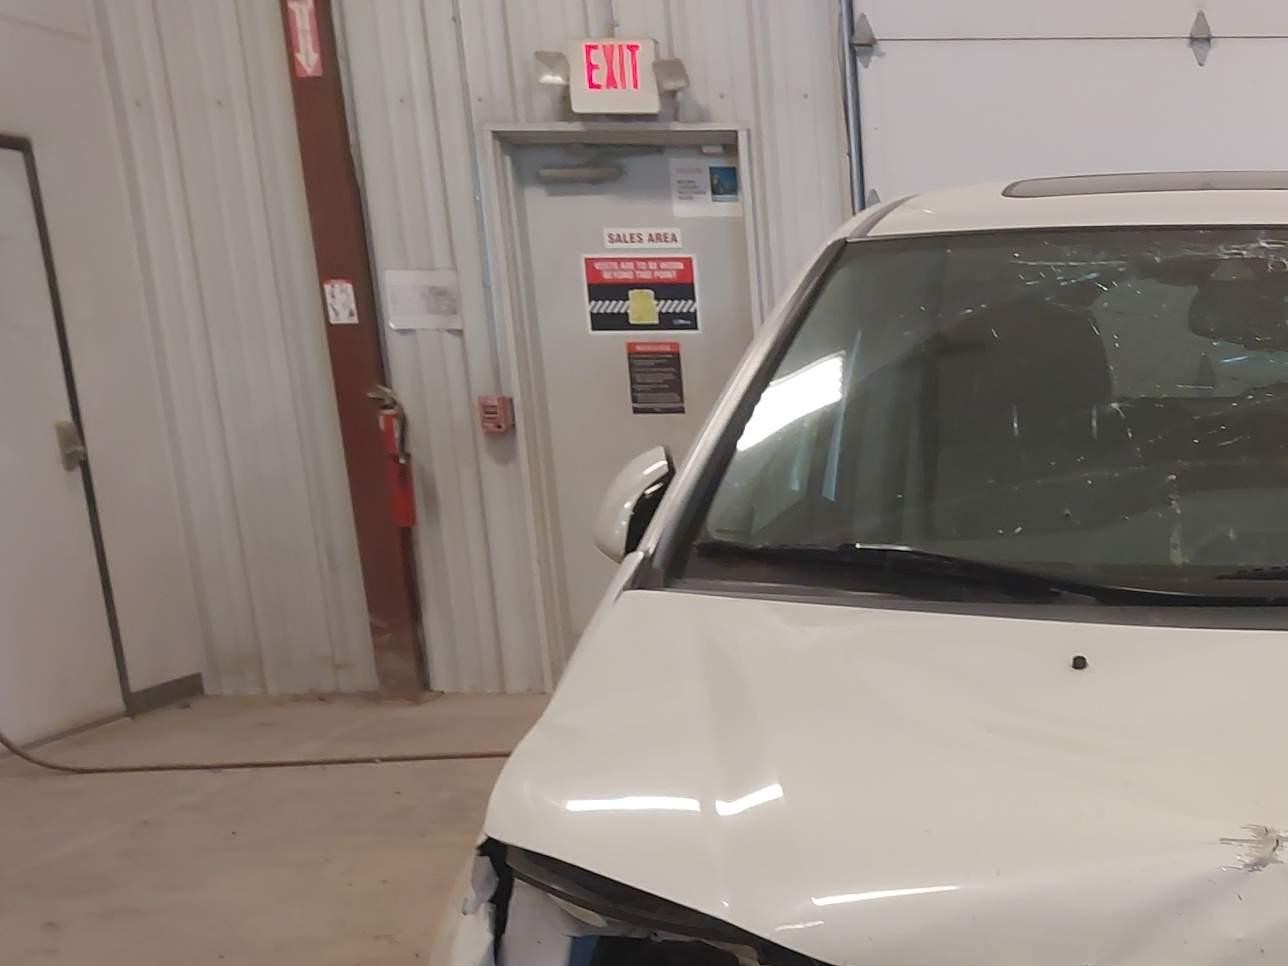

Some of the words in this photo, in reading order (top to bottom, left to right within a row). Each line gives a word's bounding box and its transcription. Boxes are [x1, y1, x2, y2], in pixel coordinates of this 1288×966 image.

[583, 43, 641, 90] EXIT
[608, 232, 643, 244] SALES
[647, 232, 678, 244] AREA
